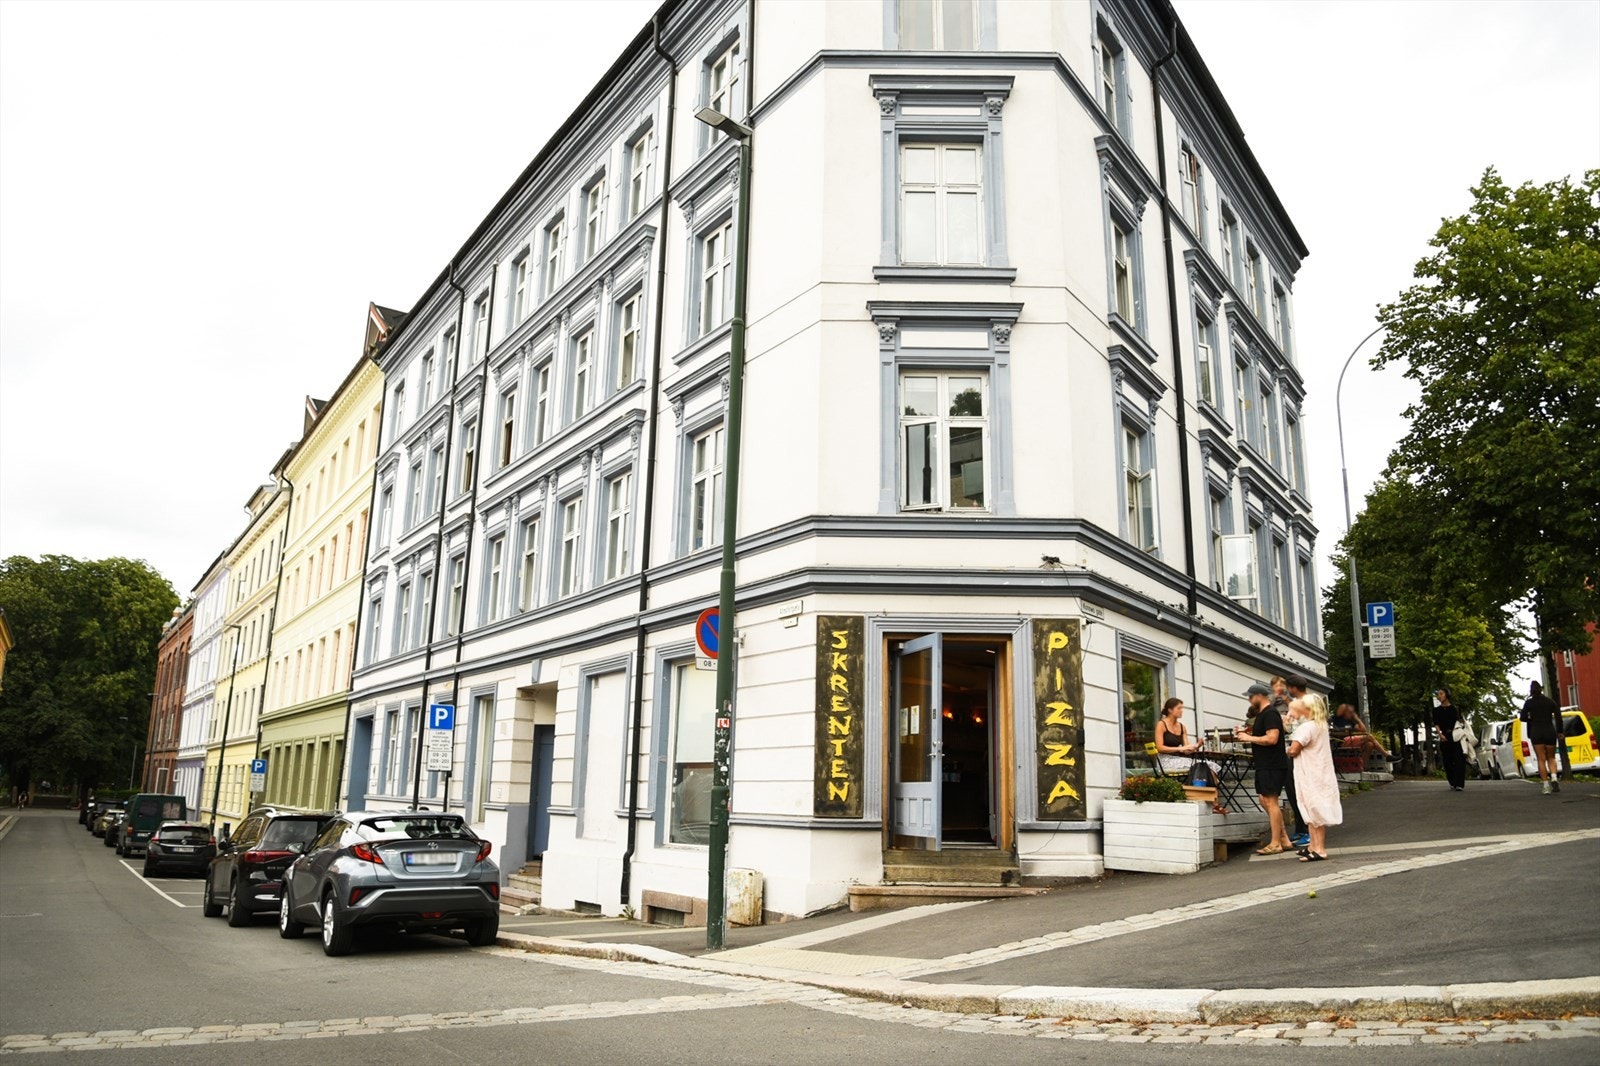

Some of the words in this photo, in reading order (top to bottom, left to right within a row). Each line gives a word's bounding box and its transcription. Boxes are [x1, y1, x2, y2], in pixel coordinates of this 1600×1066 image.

[1373, 606, 1387, 624] P
[435, 707, 448, 727] P
[829, 630, 851, 802] SKRENTEN
[1045, 631, 1080, 804] PIZZA
[254, 761, 263, 772] P
